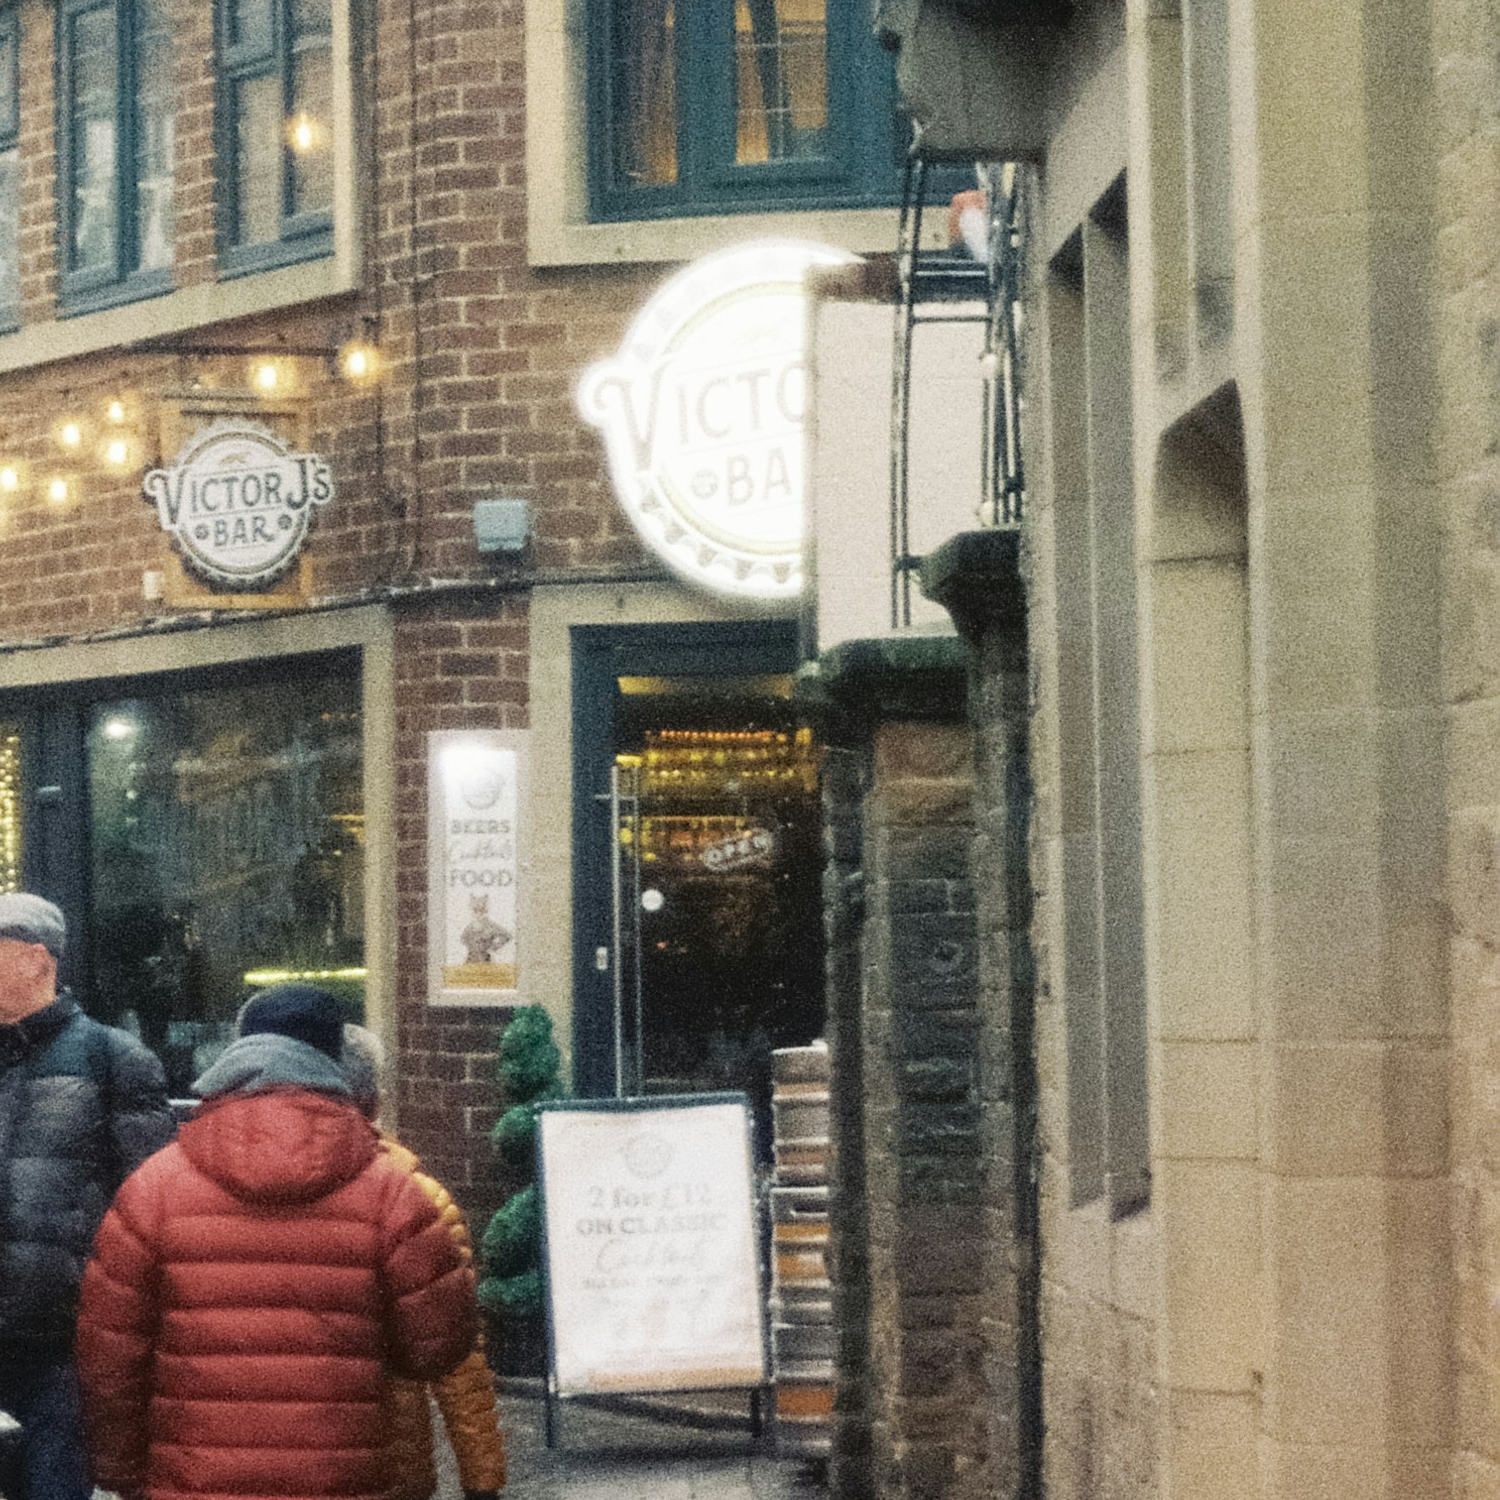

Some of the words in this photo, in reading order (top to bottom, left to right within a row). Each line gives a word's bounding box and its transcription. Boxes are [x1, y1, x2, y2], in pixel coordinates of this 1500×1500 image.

[592, 358, 807, 471] VICTO
[726, 448, 793, 508] BA
[213, 515, 275, 547] BAR
[451, 818, 511, 834] BEERS
[449, 868, 513, 888] FOOD
[575, 1217, 615, 1237] ON
[619, 1212, 728, 1236] CLASSIC
